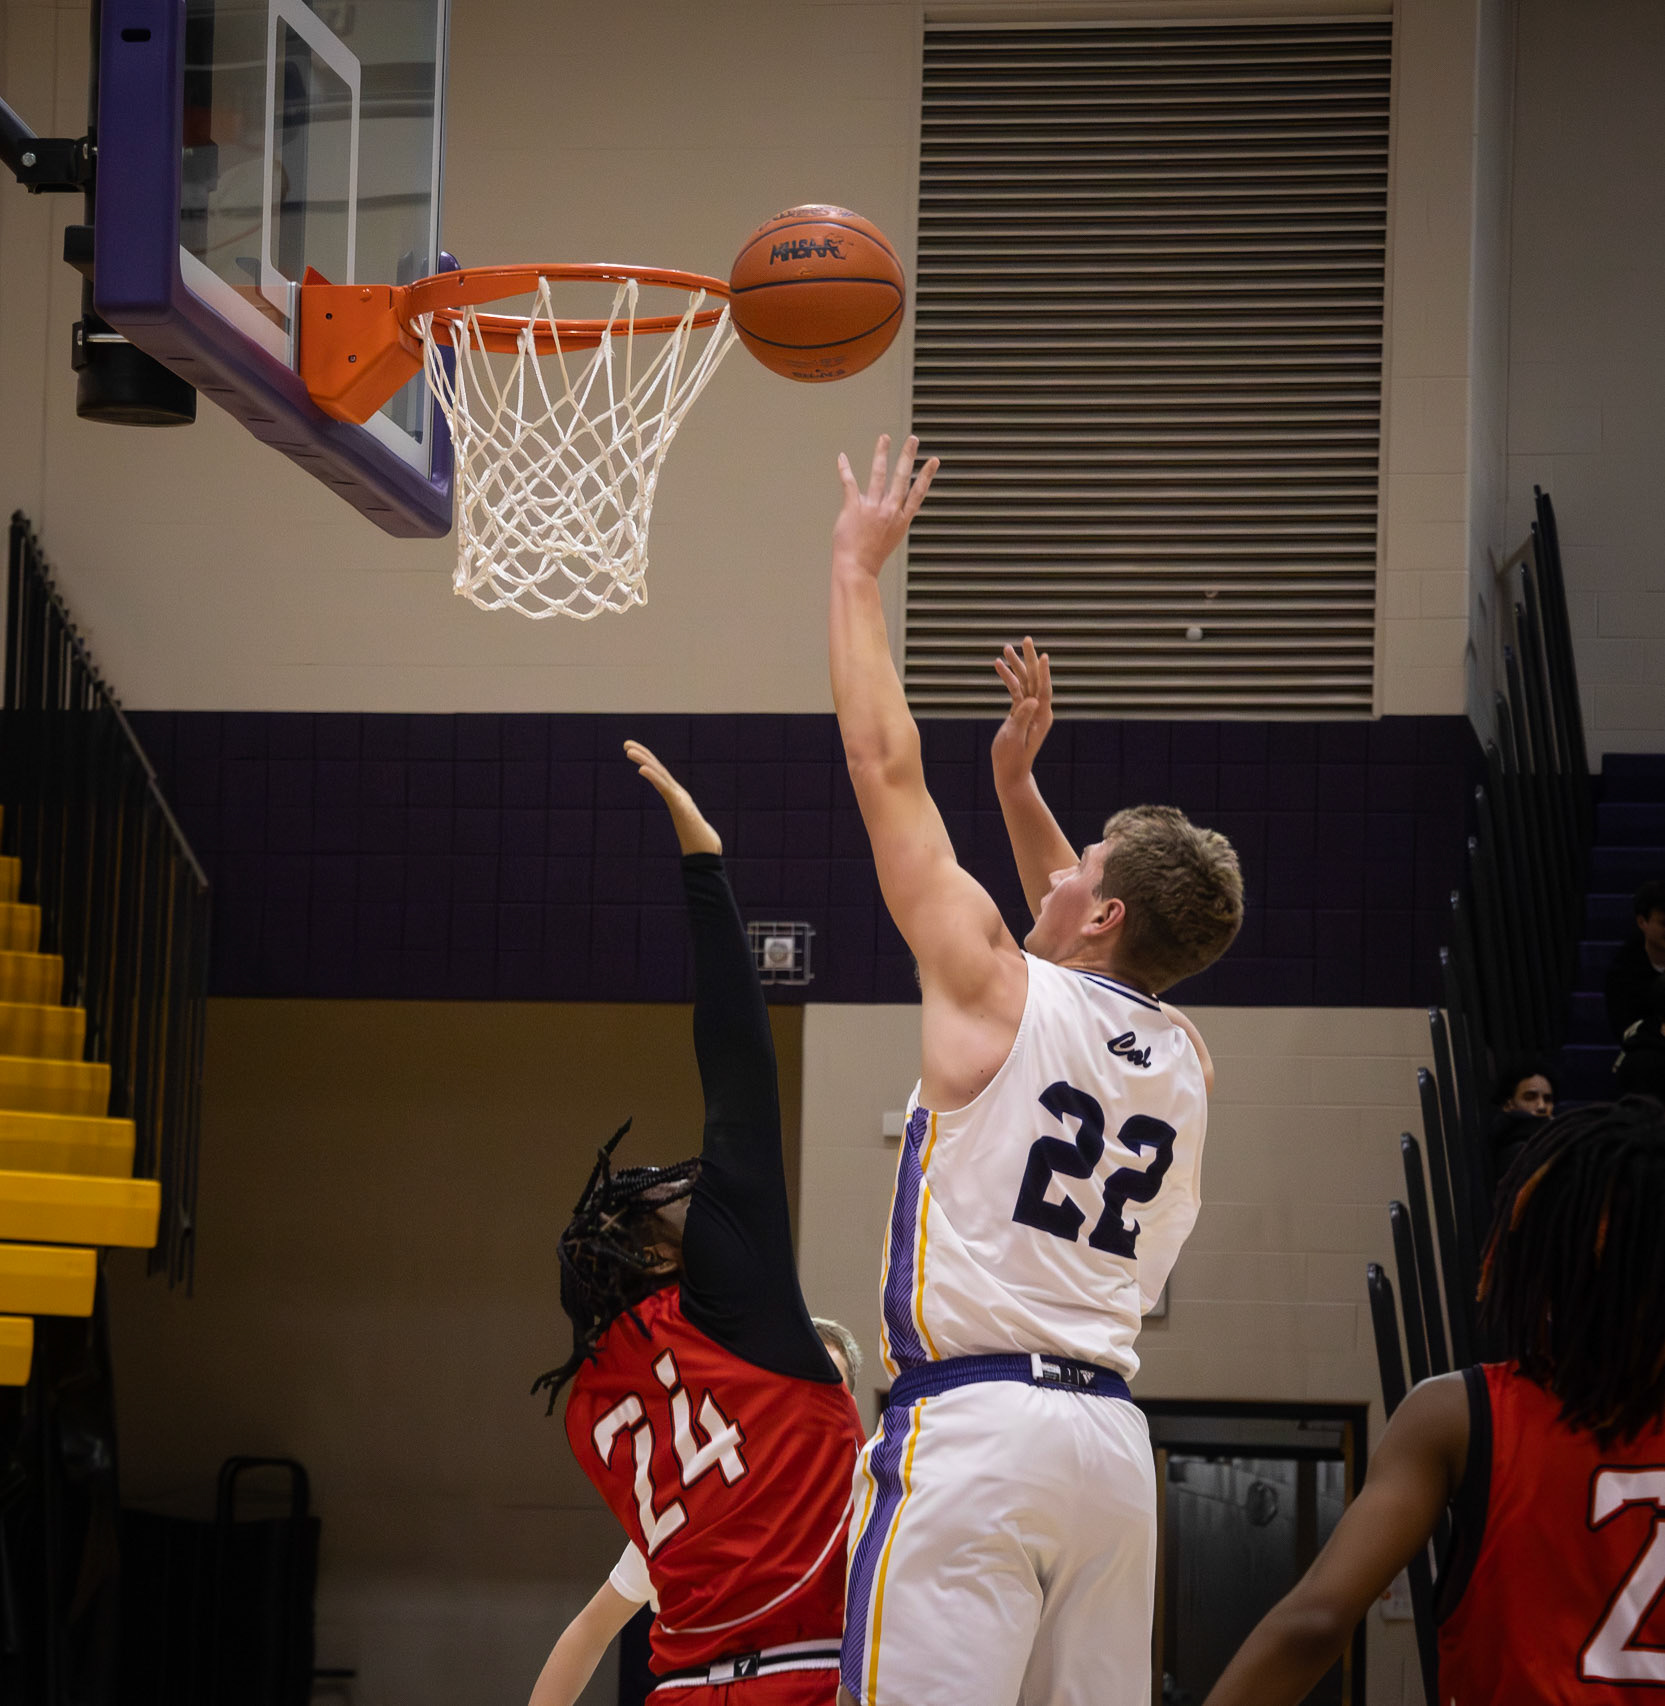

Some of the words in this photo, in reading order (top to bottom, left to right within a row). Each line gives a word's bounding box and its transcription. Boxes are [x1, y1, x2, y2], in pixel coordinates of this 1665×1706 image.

[1012, 1081, 1177, 1260] 22
[591, 1347, 749, 1559] 24
[1577, 1464, 1665, 1687] 2
